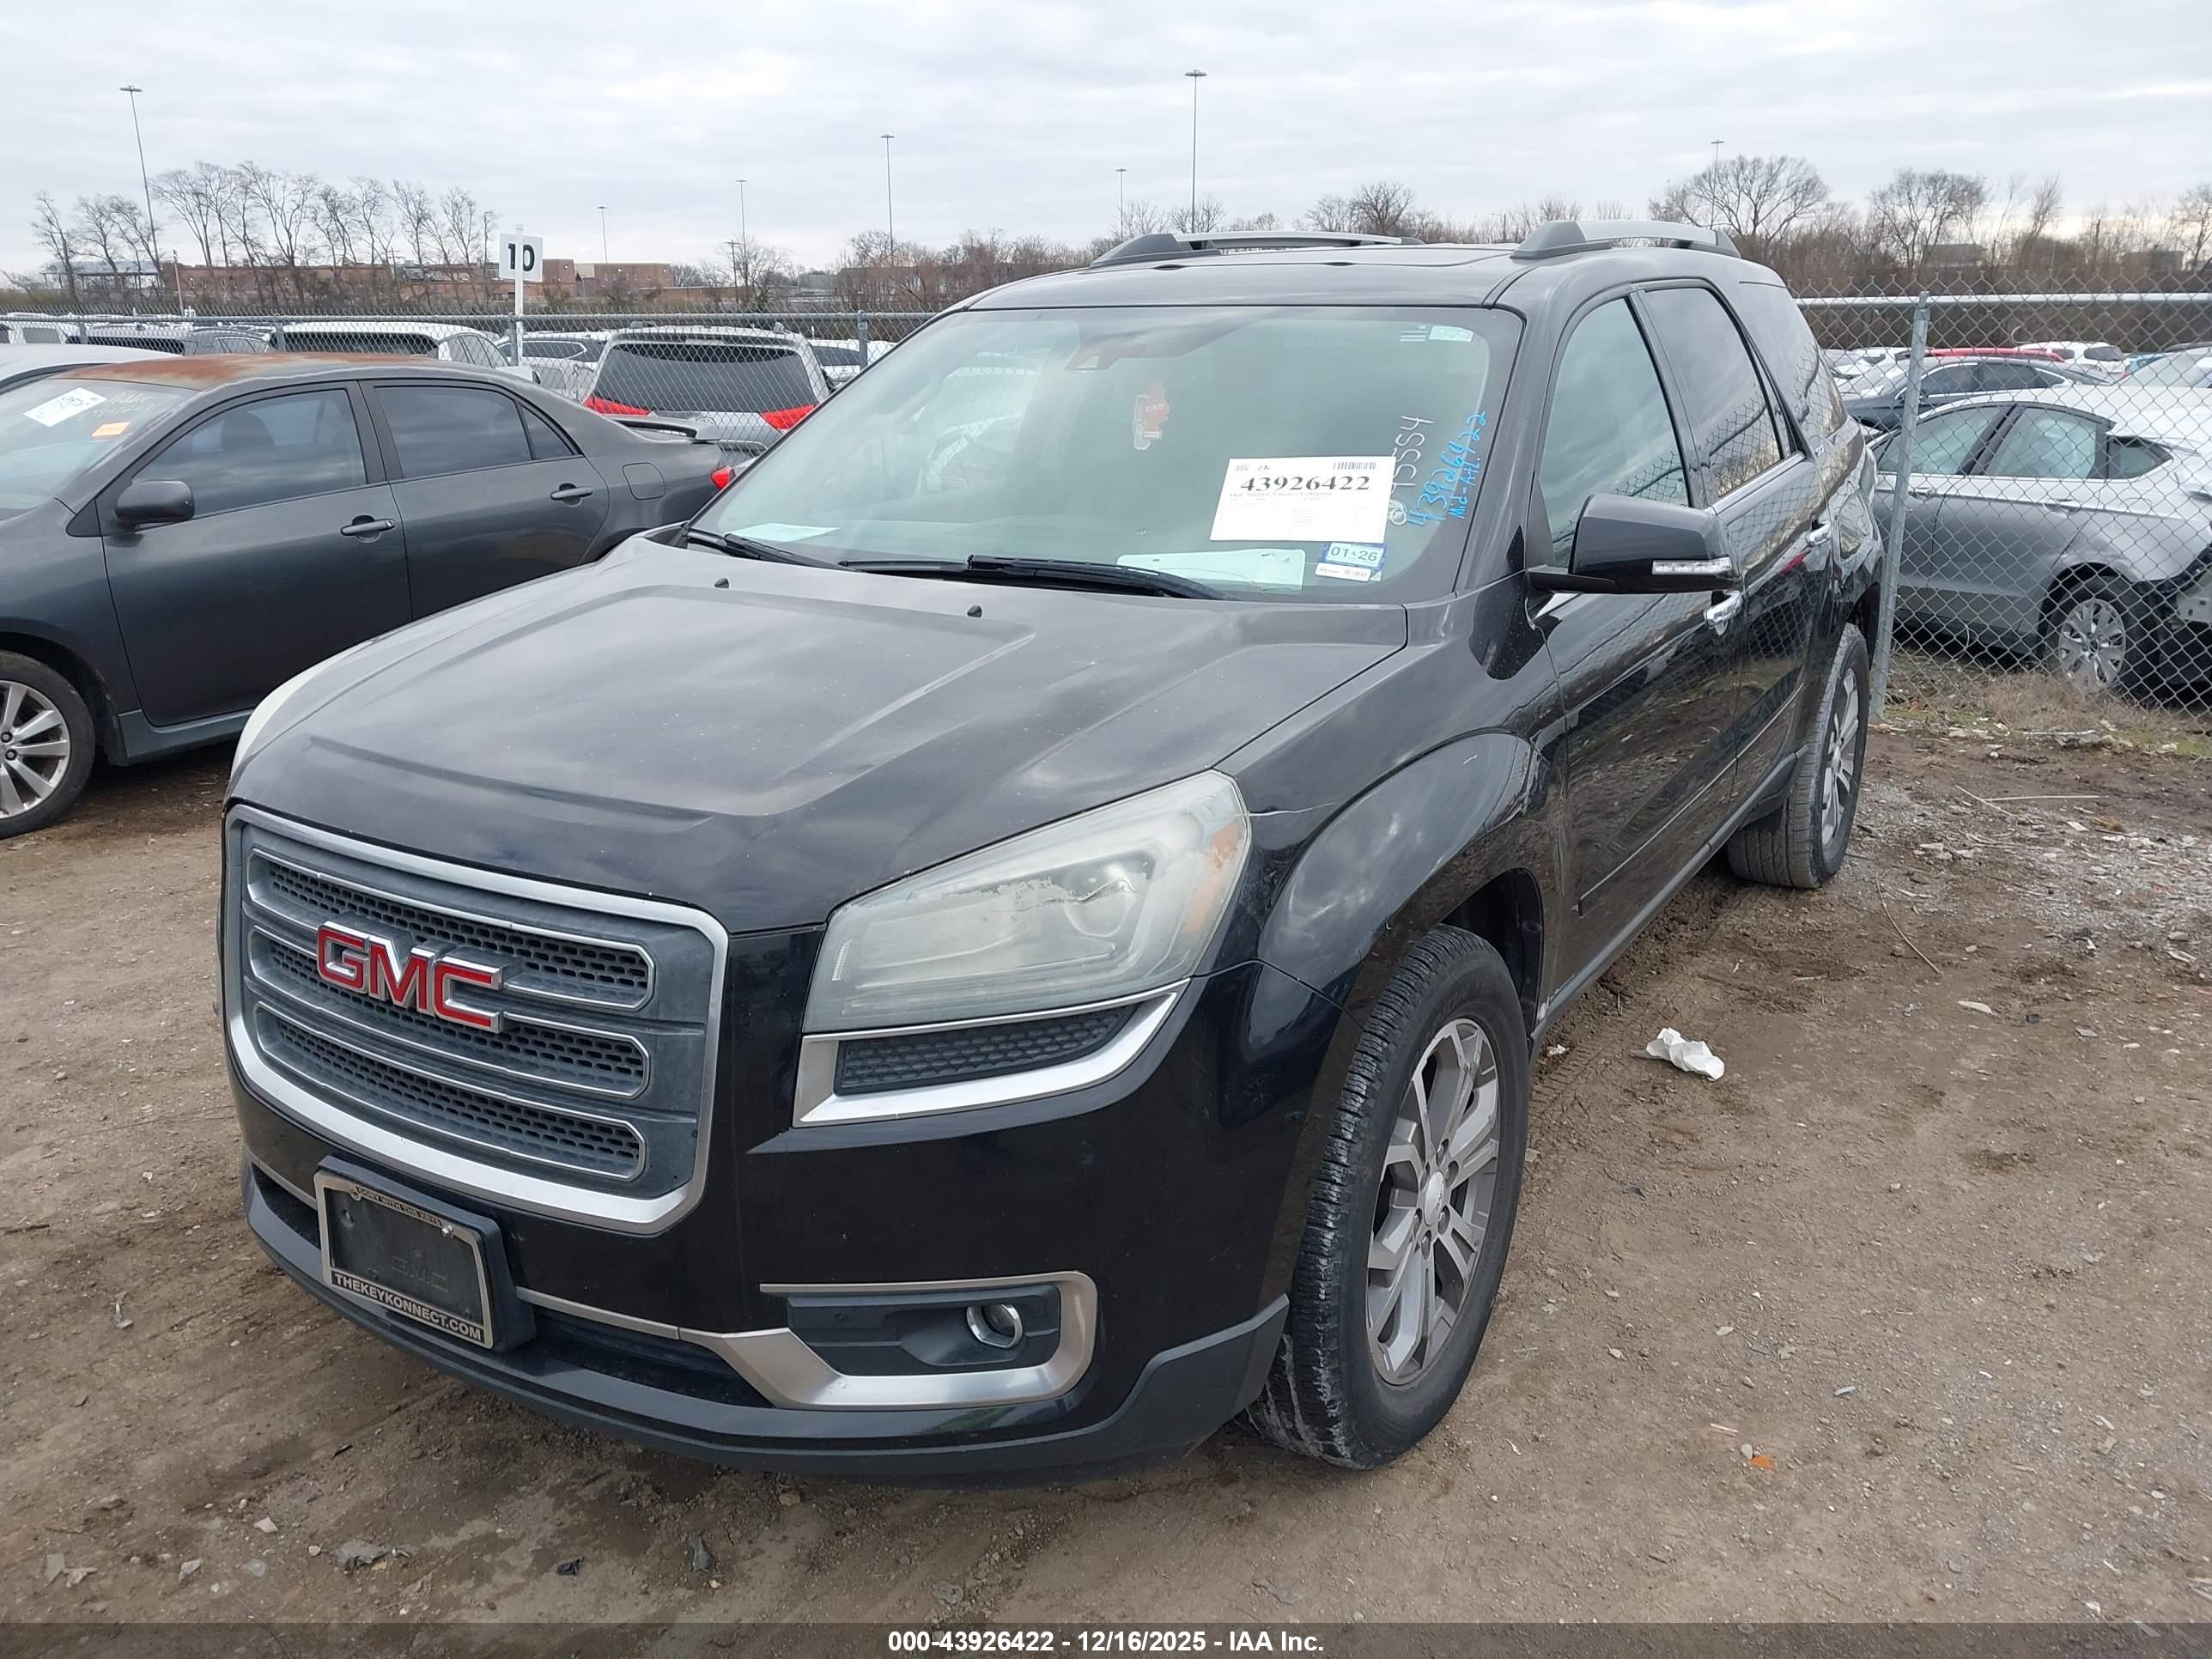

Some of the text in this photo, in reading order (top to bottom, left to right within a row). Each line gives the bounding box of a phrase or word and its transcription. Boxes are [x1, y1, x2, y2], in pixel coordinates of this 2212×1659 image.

[1240, 475, 1370, 492] 43926422
[1331, 546, 1378, 562] 01 26
[316, 921, 502, 1034] GMC
[334, 1273, 482, 1342] THEKEYKONNECT.COM
